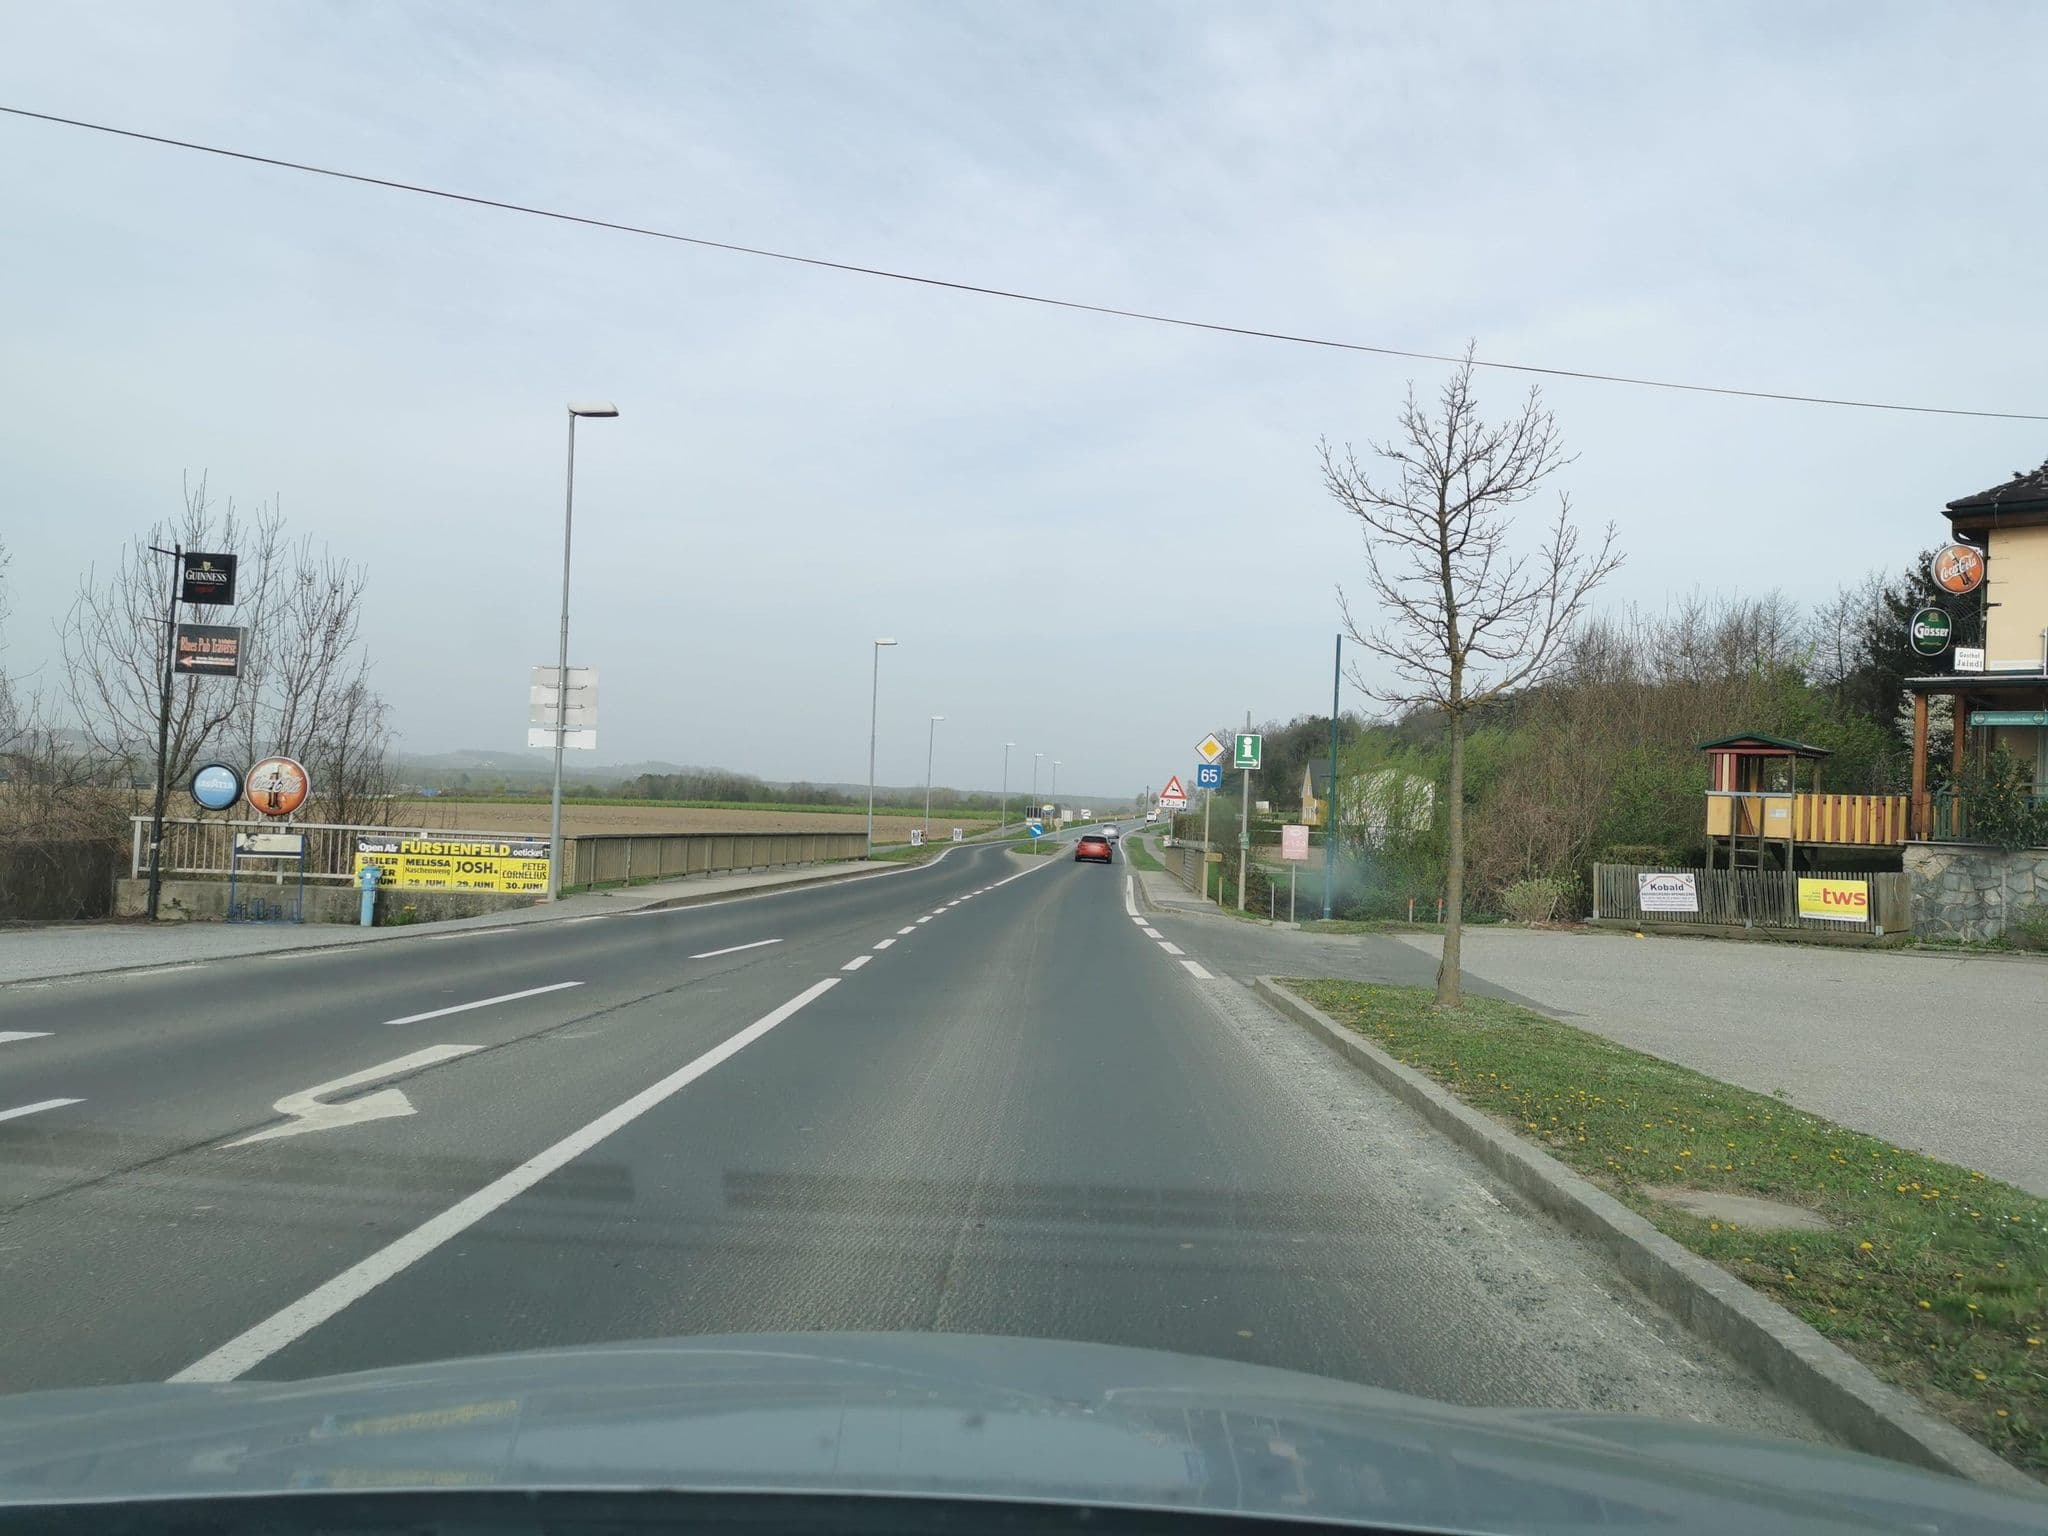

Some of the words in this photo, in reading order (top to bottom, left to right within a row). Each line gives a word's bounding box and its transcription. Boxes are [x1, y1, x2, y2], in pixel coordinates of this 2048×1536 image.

[185, 570, 228, 583] GUINNESS
[1914, 622, 1949, 639] Gösser
[1201, 769, 1218, 783] 65
[359, 842, 384, 852] Open
[384, 844, 399, 852] Air
[400, 838, 511, 856] FÜRSTENFELD
[512, 848, 544, 857] oeticket
[361, 856, 398, 865] SEILER
[405, 858, 451, 868] MELISSA
[455, 861, 499, 875] JOSH.
[522, 862, 547, 871] PETER
[502, 870, 547, 880] CORNELIUS
[426, 879, 446, 888] JUNI
[473, 881, 494, 889] JUNI
[505, 882, 520, 890] 30.
[1650, 883, 1684, 891] Kobald
[1822, 887, 1866, 906] tws
